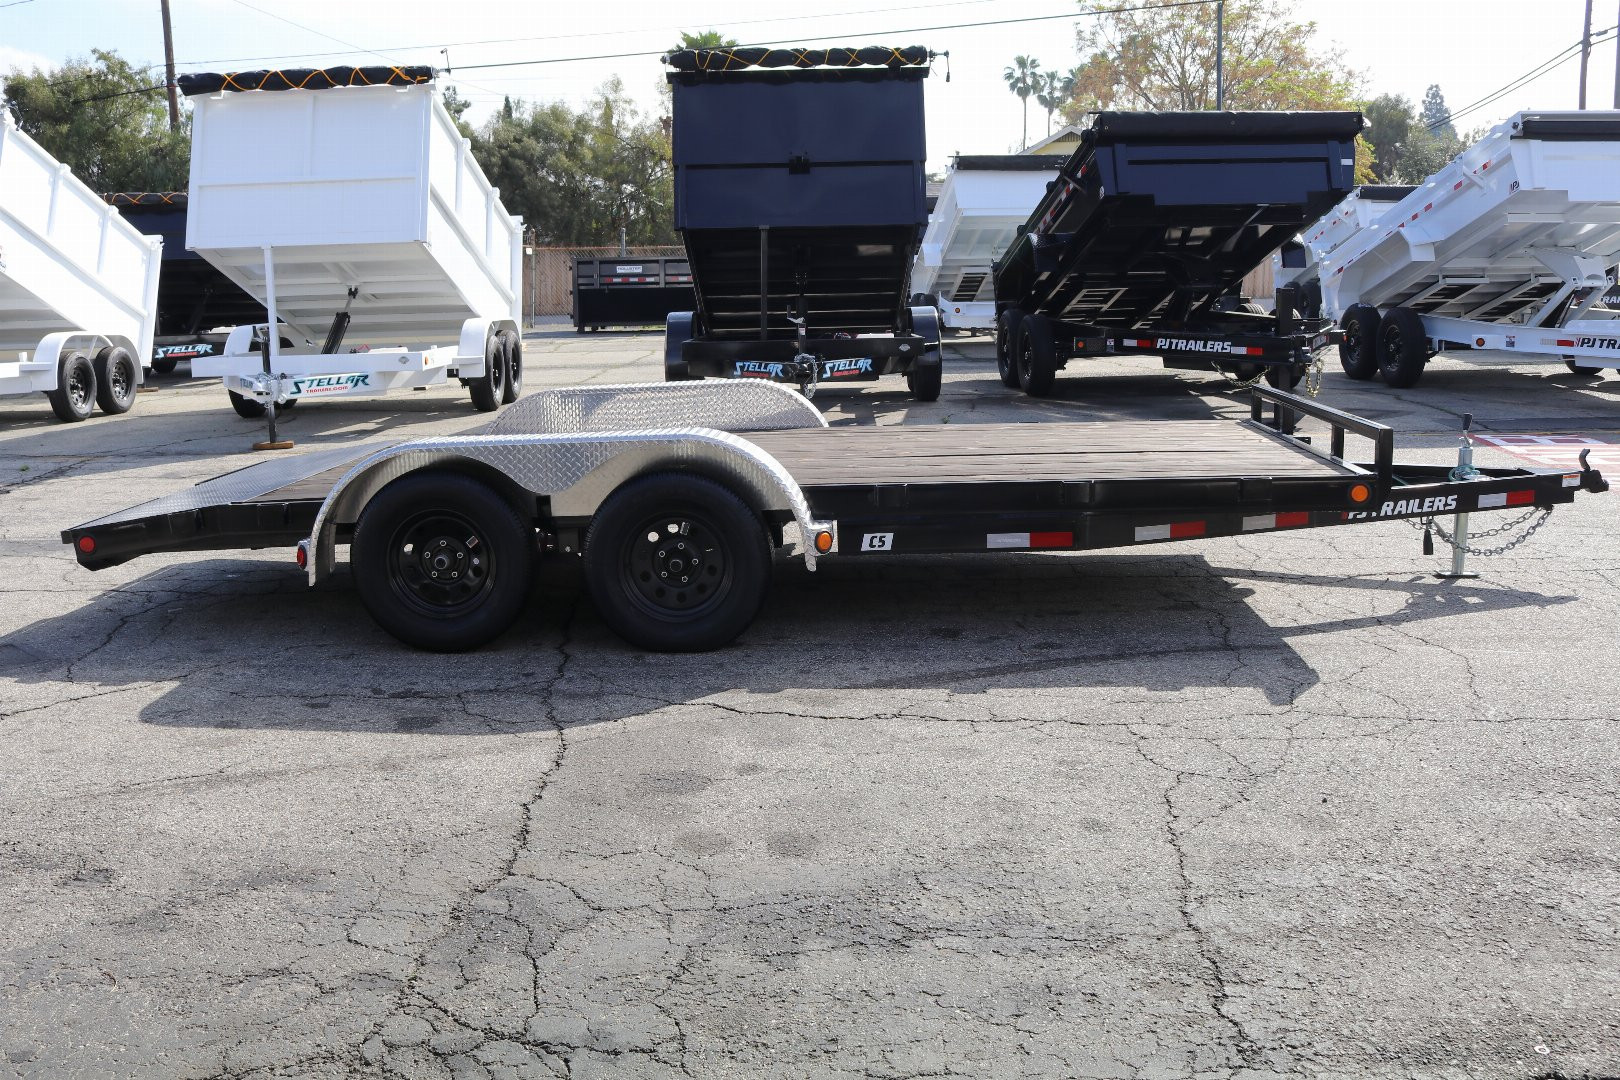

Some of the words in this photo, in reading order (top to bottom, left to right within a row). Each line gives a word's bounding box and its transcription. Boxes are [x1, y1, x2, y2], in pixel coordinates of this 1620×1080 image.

[155, 343, 213, 359] STELLAR
[734, 361, 784, 377] STELLAR
[822, 359, 872, 379] STELLAR
[290, 374, 370, 395] STELLAR
[868, 535, 886, 549] C5
